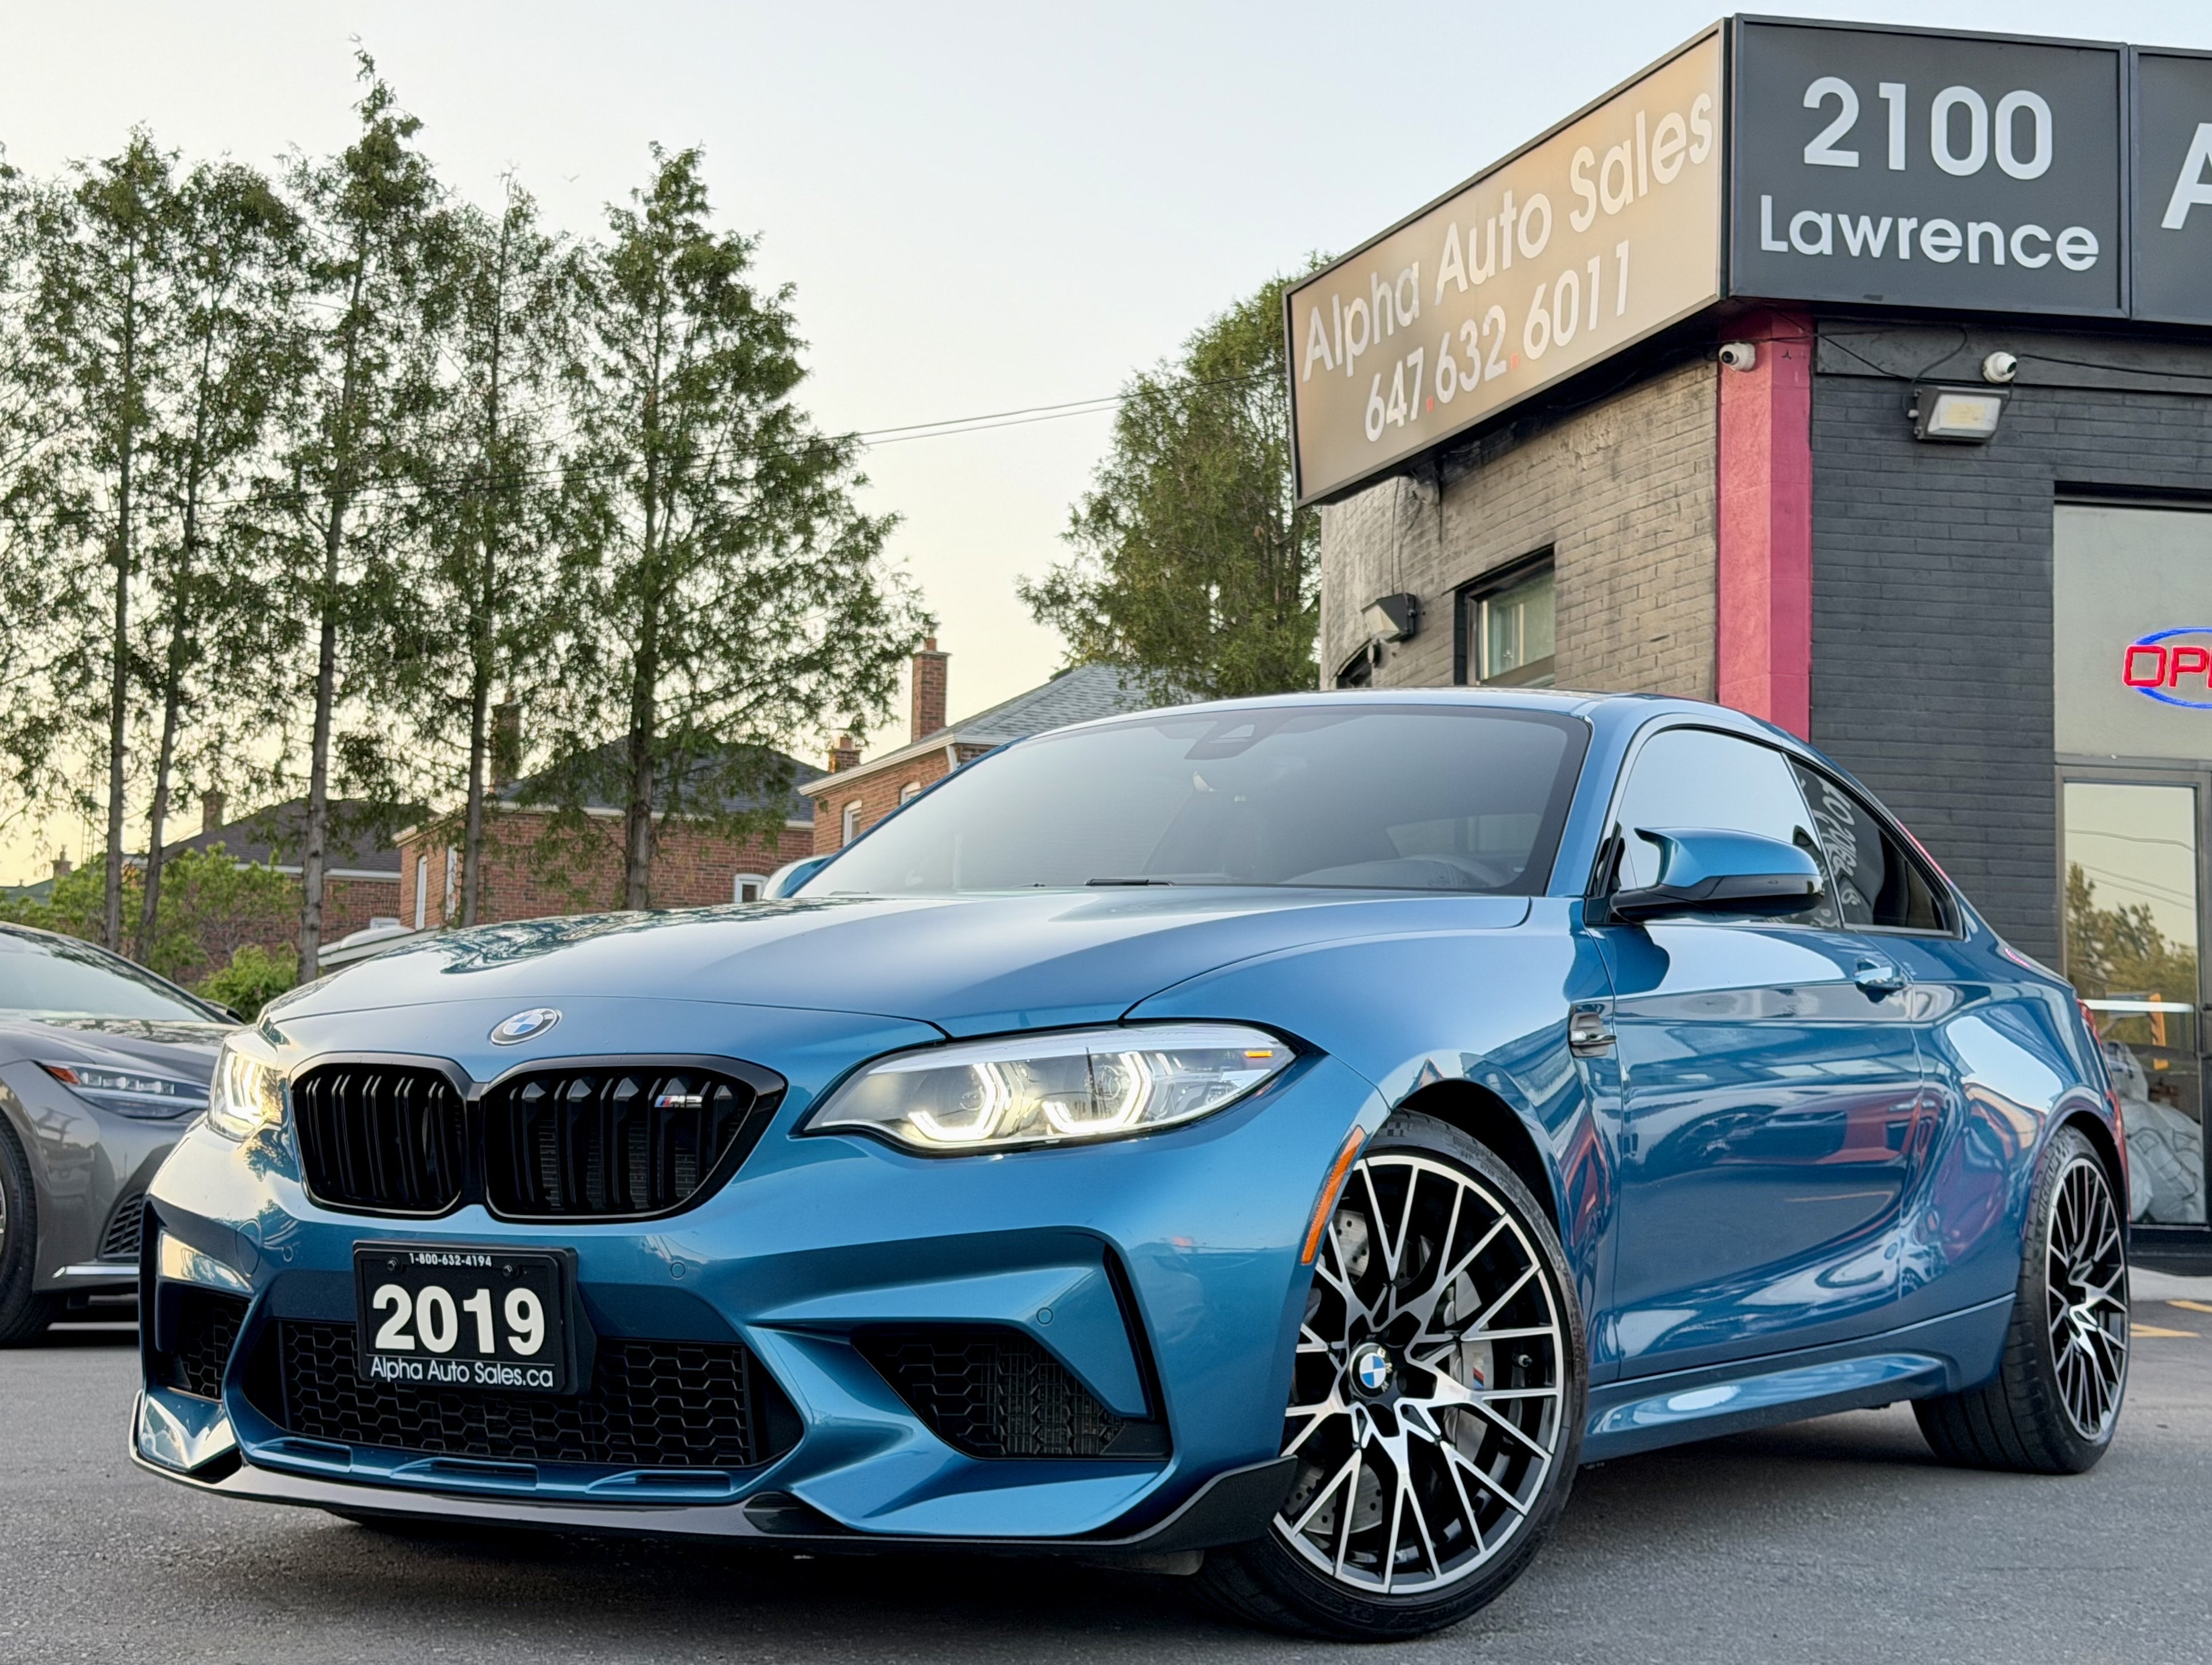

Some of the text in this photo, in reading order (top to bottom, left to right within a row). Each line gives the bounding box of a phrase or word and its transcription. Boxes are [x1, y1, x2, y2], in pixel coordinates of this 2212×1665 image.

[1803, 76, 2053, 180] 2100
[1302, 92, 1713, 383] Alpha Auto Sales
[1760, 195, 2100, 272] Lawrence
[1364, 240, 1630, 443] 647.632.6011
[2122, 645, 2212, 689] OP
[668, 1094, 703, 1109] M2
[409, 1252, 492, 1267] 1-800-632-4194
[373, 1283, 545, 1356] 2019
[370, 1356, 554, 1388] Alpha Auto Sales.ca
